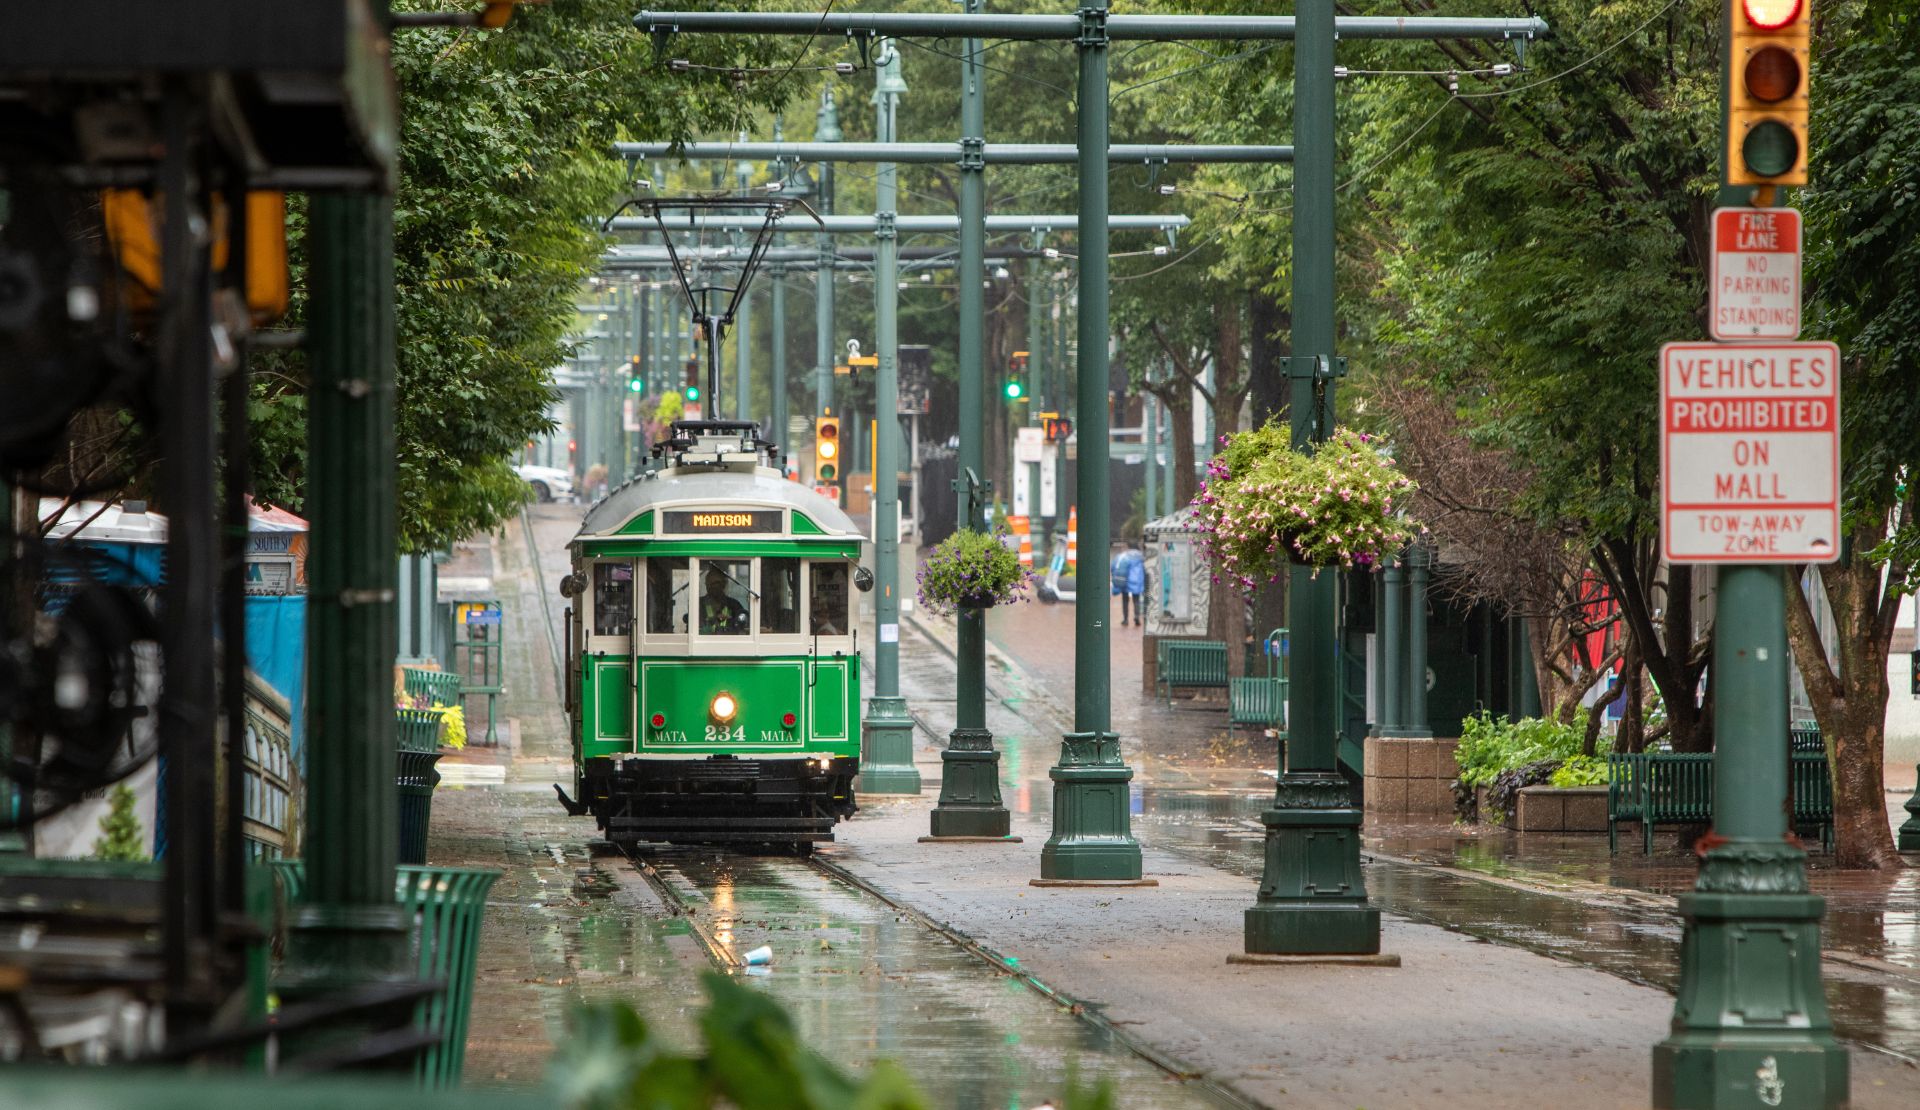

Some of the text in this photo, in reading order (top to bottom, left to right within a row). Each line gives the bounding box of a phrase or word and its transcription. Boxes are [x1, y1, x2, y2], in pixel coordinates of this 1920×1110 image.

[1740, 213, 1777, 231] FIRE
[1736, 231, 1779, 249] LANE
[1746, 256, 1768, 273] NO
[1723, 276, 1791, 295] PARKING
[1719, 307, 1794, 326] STANDING
[1676, 358, 1826, 389] VEHICLES
[1672, 400, 1828, 428] PROHIBITED
[1733, 440, 1769, 466] ON
[1714, 473, 1787, 499] MALL
[692, 513, 752, 527] MADISON
[1697, 515, 1805, 533] TOW-AWAY
[254, 535, 280, 552] SOUTH
[1724, 535, 1779, 553] ZONE
[654, 730, 688, 742] MATA
[704, 725, 746, 742] 234
[760, 730, 793, 742] MATA
